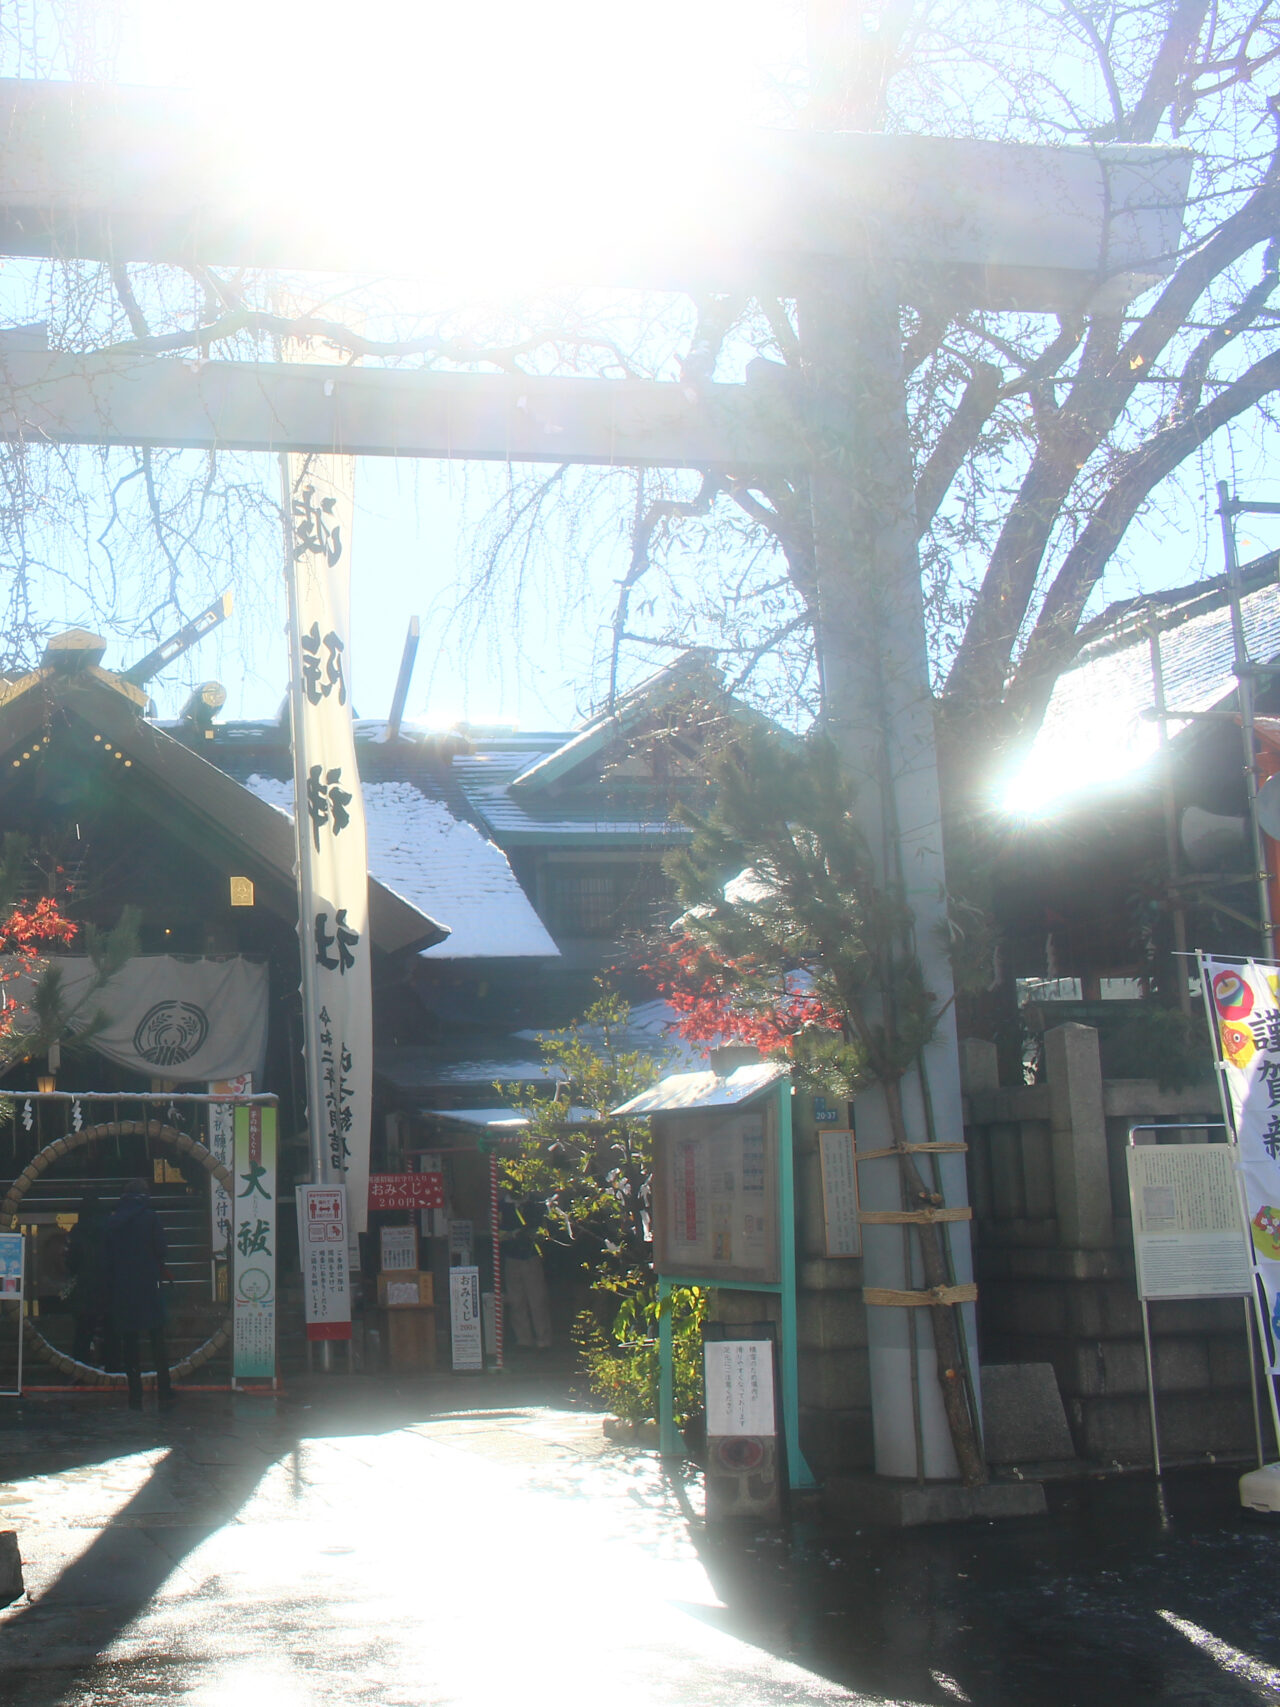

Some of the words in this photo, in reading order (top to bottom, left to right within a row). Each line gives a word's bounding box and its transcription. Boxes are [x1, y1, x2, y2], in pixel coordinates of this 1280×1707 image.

[371, 1183, 421, 1196] おみくじ
[379, 1197, 415, 1207] 200円
[237, 1162, 272, 1257] 大祓
[460, 1275, 471, 1321] おみくじ
